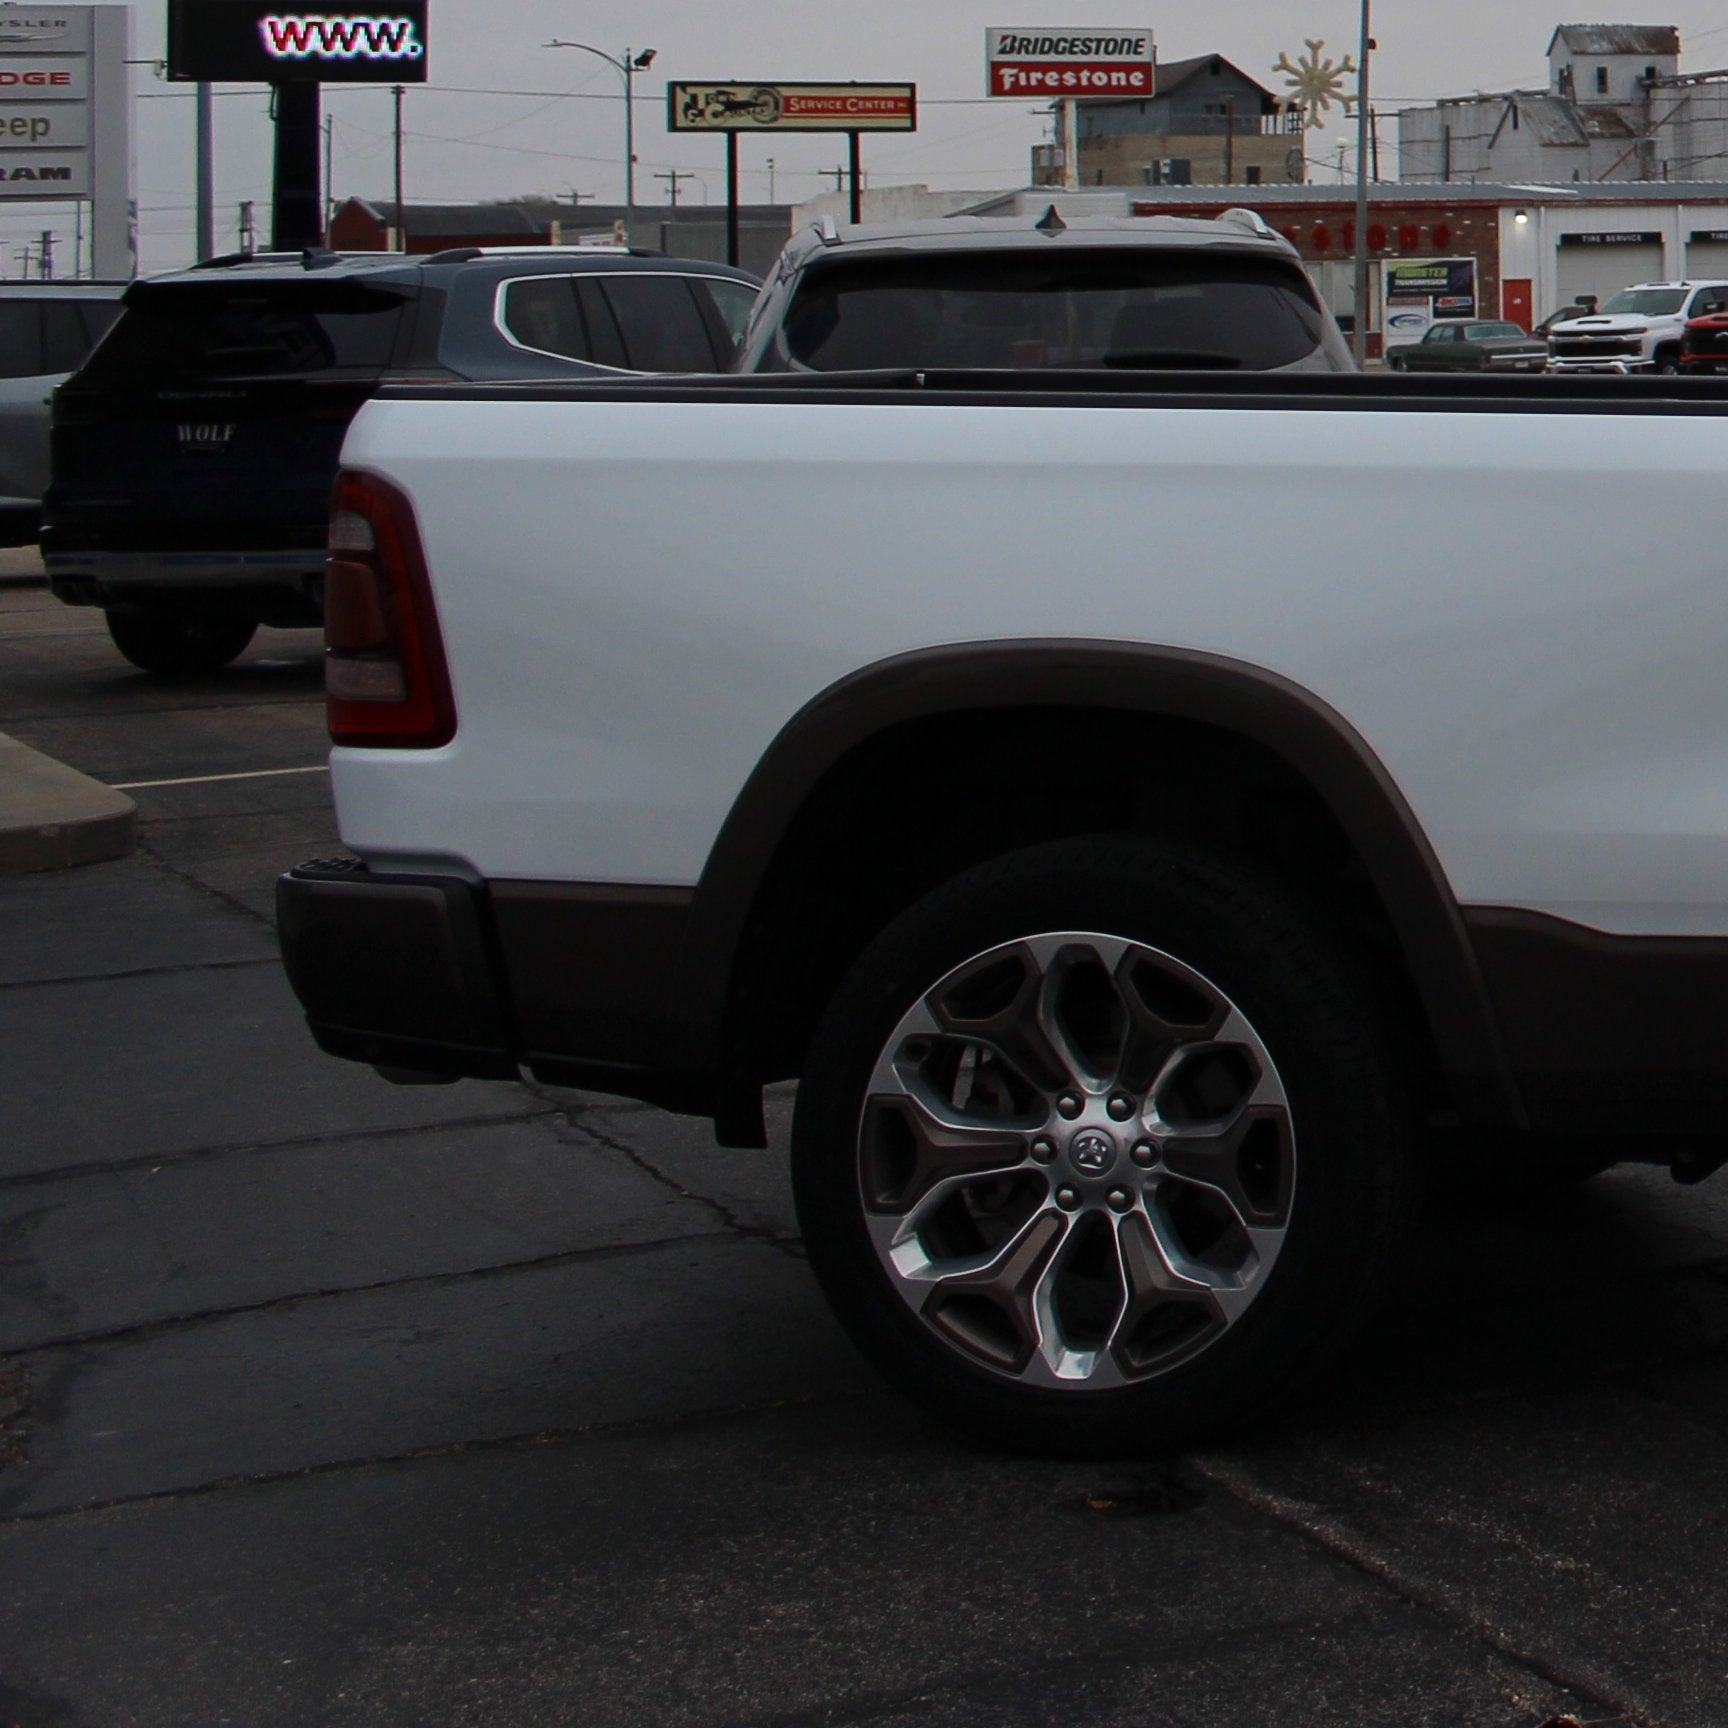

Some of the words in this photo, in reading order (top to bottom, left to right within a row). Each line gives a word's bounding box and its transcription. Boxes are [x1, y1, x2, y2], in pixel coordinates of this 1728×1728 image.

[0, 20, 67, 28] SLER
[997, 34, 1146, 56] BRIDGESTONE
[999, 67, 1145, 91] Firestone
[789, 97, 843, 112] SERVICE
[846, 97, 896, 112] CENTER
[1606, 234, 1643, 243] SERVICE
[176, 423, 238, 442] WOLF
